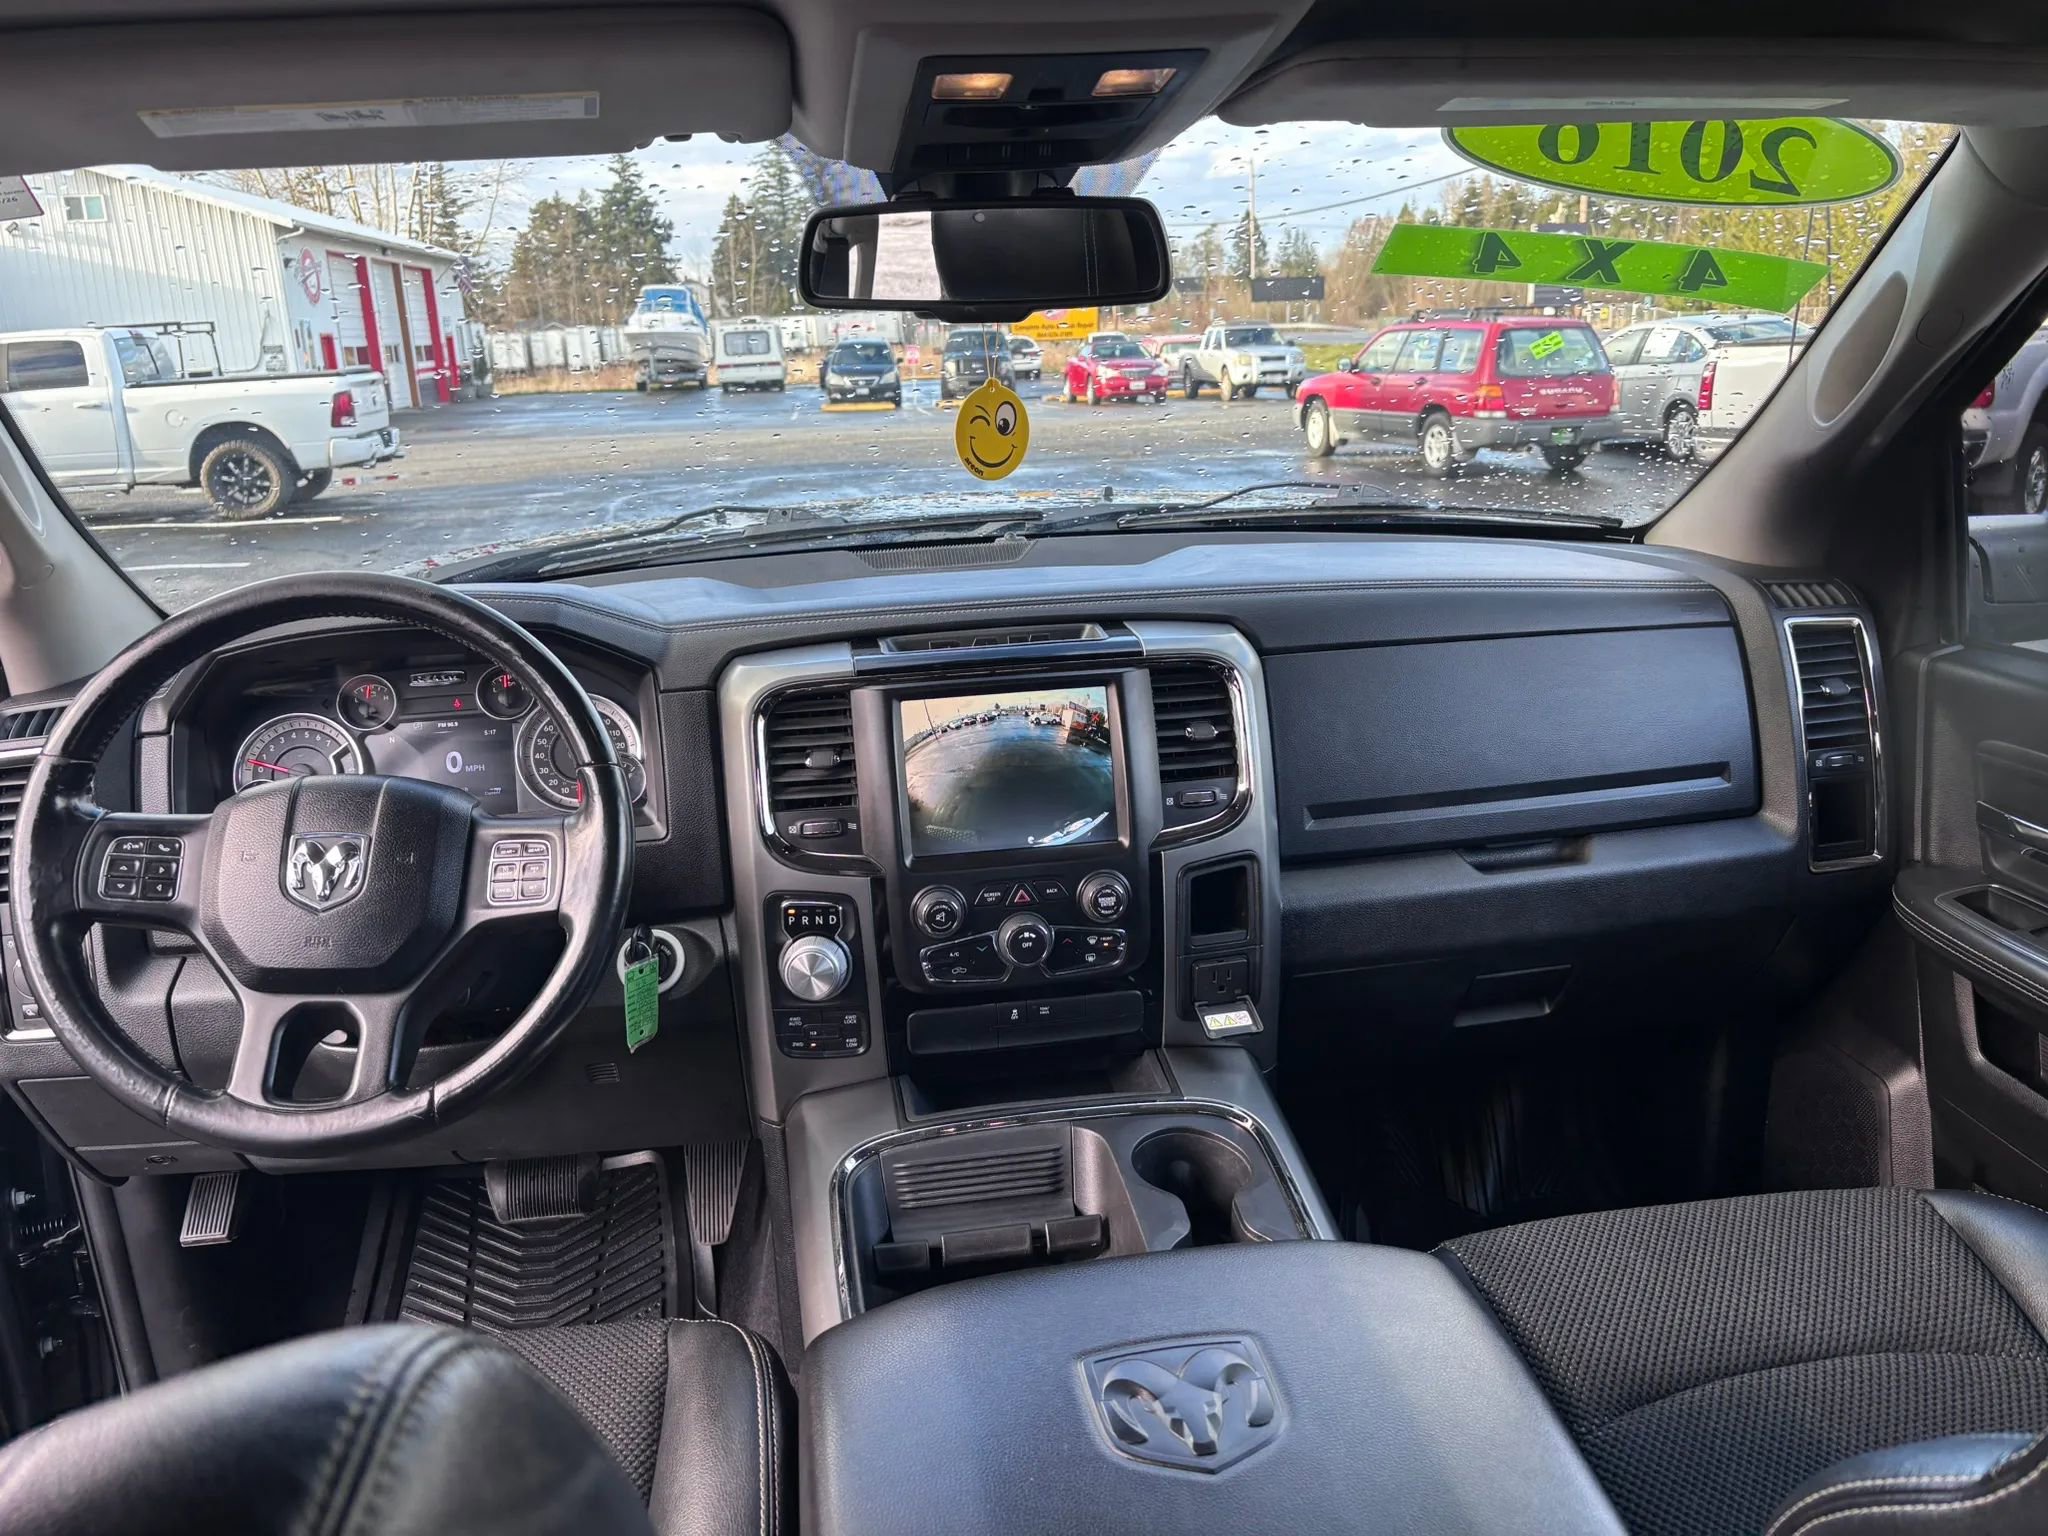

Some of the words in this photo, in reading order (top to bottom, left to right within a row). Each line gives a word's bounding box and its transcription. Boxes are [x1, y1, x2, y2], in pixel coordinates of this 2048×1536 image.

[1540, 386, 1584, 395] SUBARU
[964, 456, 984, 476] areon
[446, 751, 463, 773] 0
[465, 764, 486, 772] MPH
[788, 916, 796, 926] P
[802, 916, 809, 925] R
[816, 916, 823, 924] N
[829, 915, 836, 924] D
